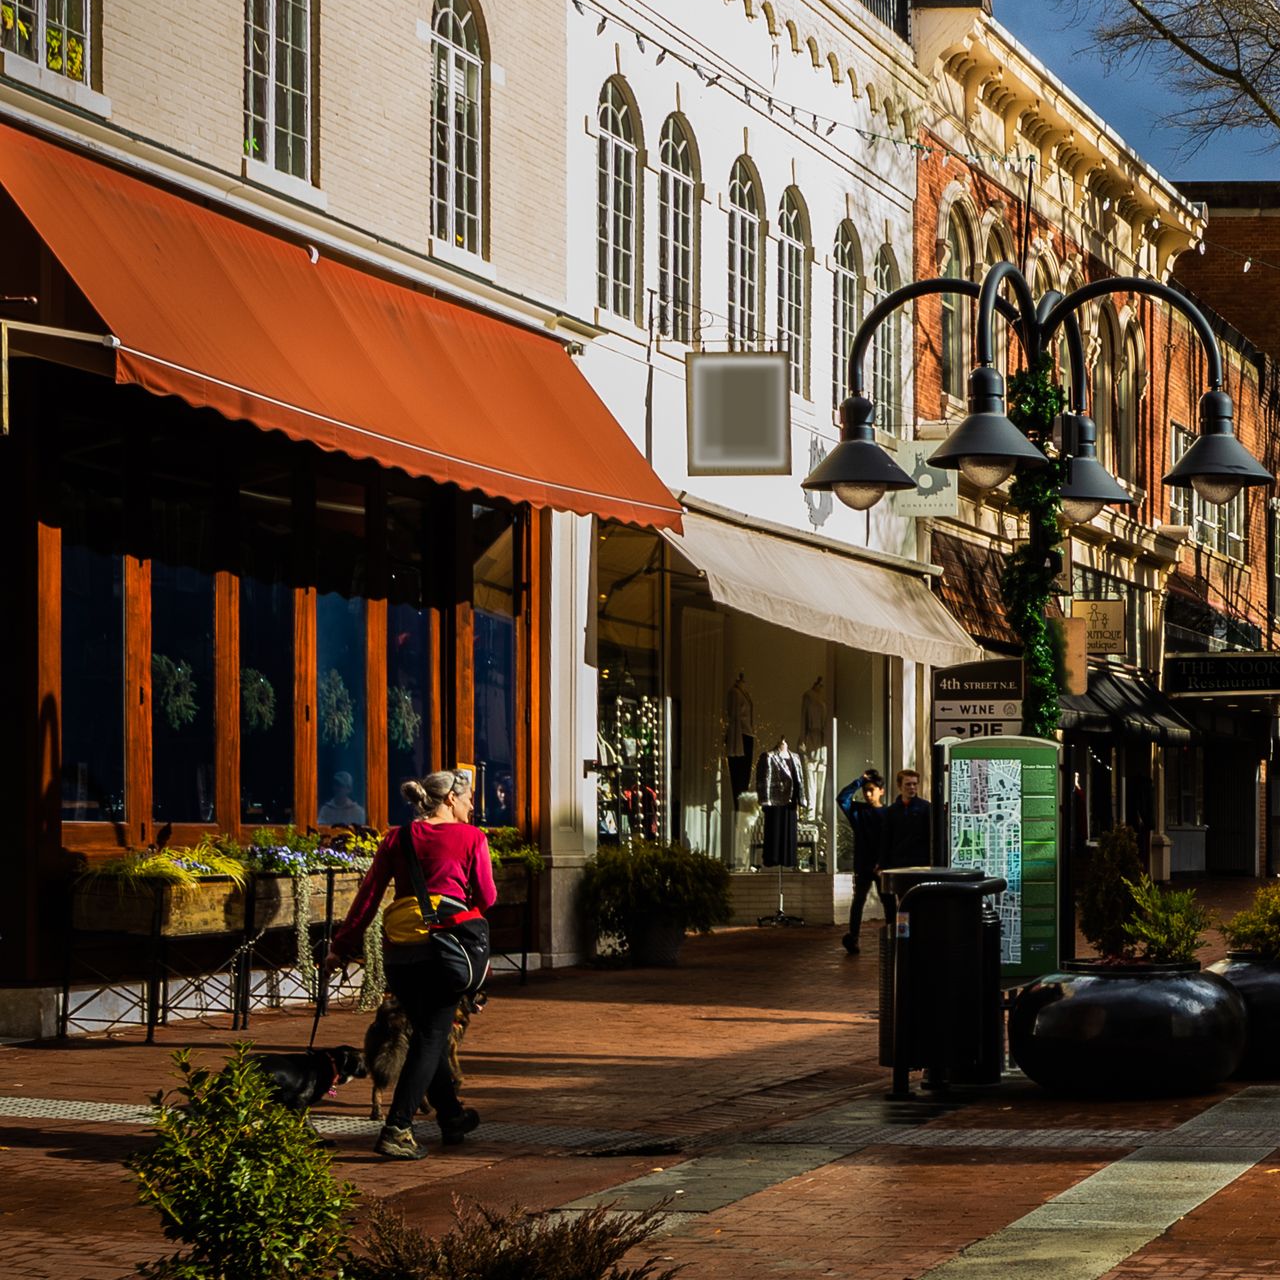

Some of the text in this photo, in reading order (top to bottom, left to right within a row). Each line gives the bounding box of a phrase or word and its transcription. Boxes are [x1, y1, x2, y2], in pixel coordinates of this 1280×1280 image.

[1178, 660, 1280, 674] THE NOOK
[940, 678, 1017, 690] 4th STREET N.E.
[1187, 676, 1272, 689] Restaurant
[960, 704, 995, 715] WINE
[969, 723, 1003, 737] PIE
